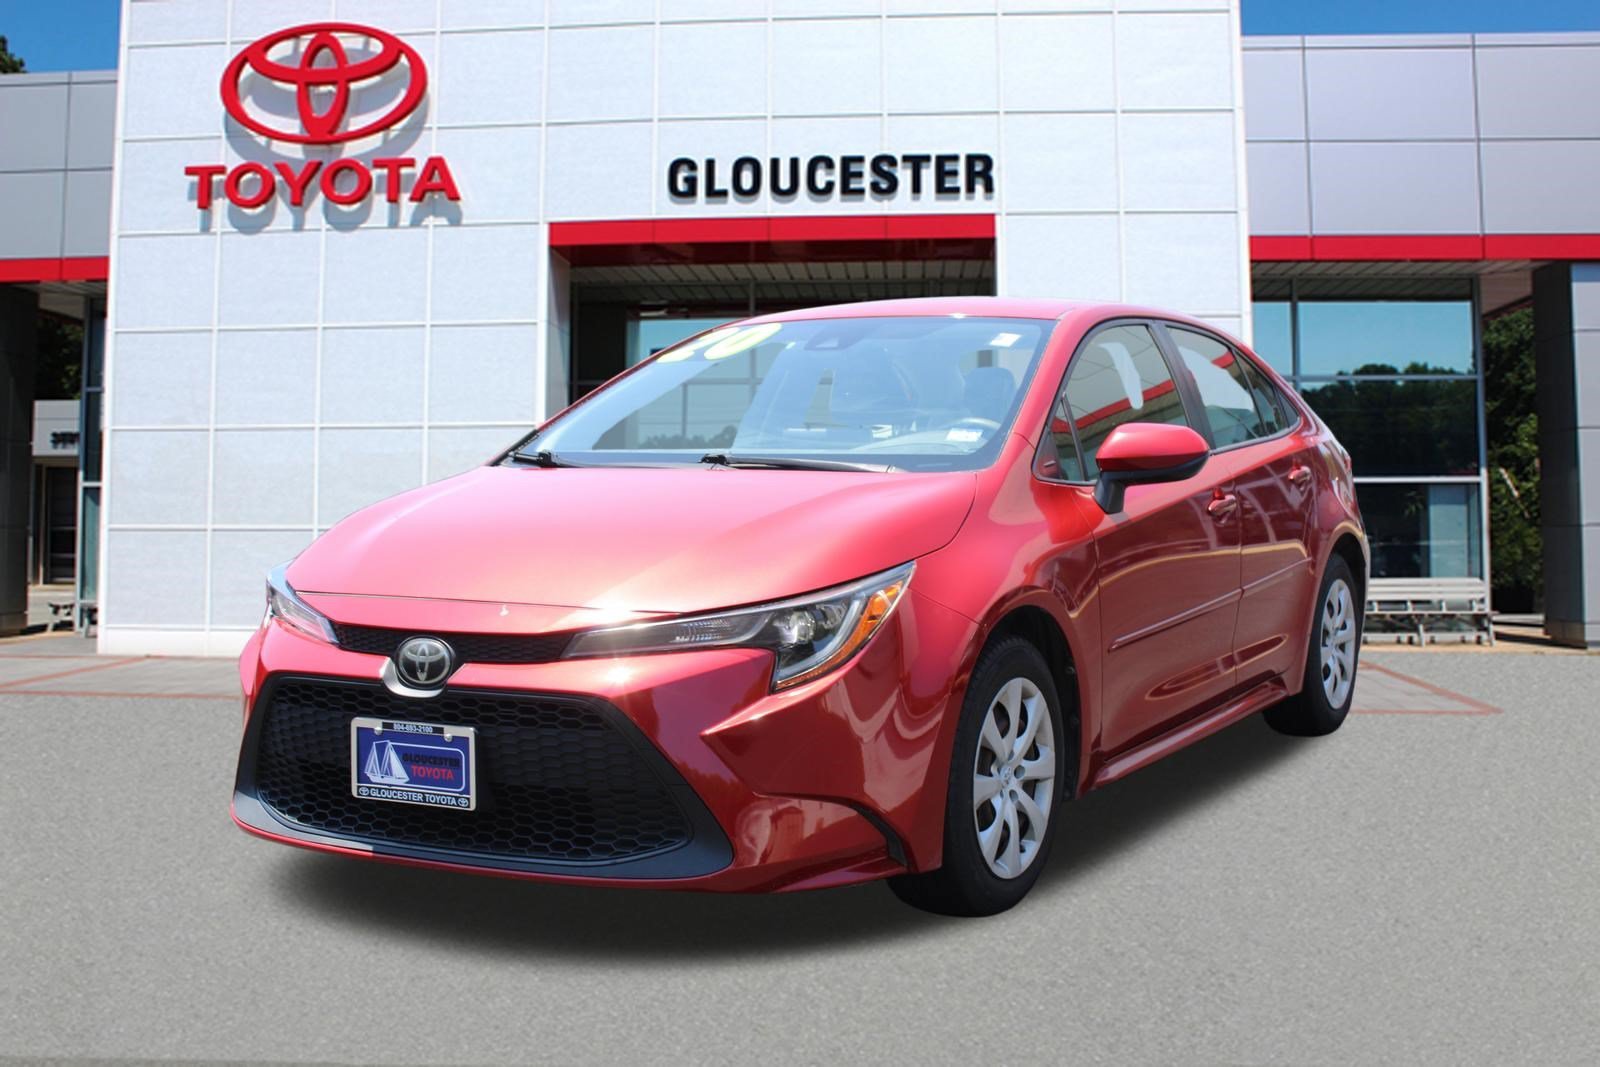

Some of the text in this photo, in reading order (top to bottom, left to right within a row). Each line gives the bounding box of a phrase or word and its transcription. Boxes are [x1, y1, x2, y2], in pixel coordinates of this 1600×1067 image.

[185, 156, 461, 209] TOYOTA
[668, 153, 995, 198] GLOUCESTER
[403, 754, 460, 767] GLOUCESTER
[412, 765, 454, 779] TOYOTA
[370, 787, 457, 806] GLOUCESTER TOYOTA
